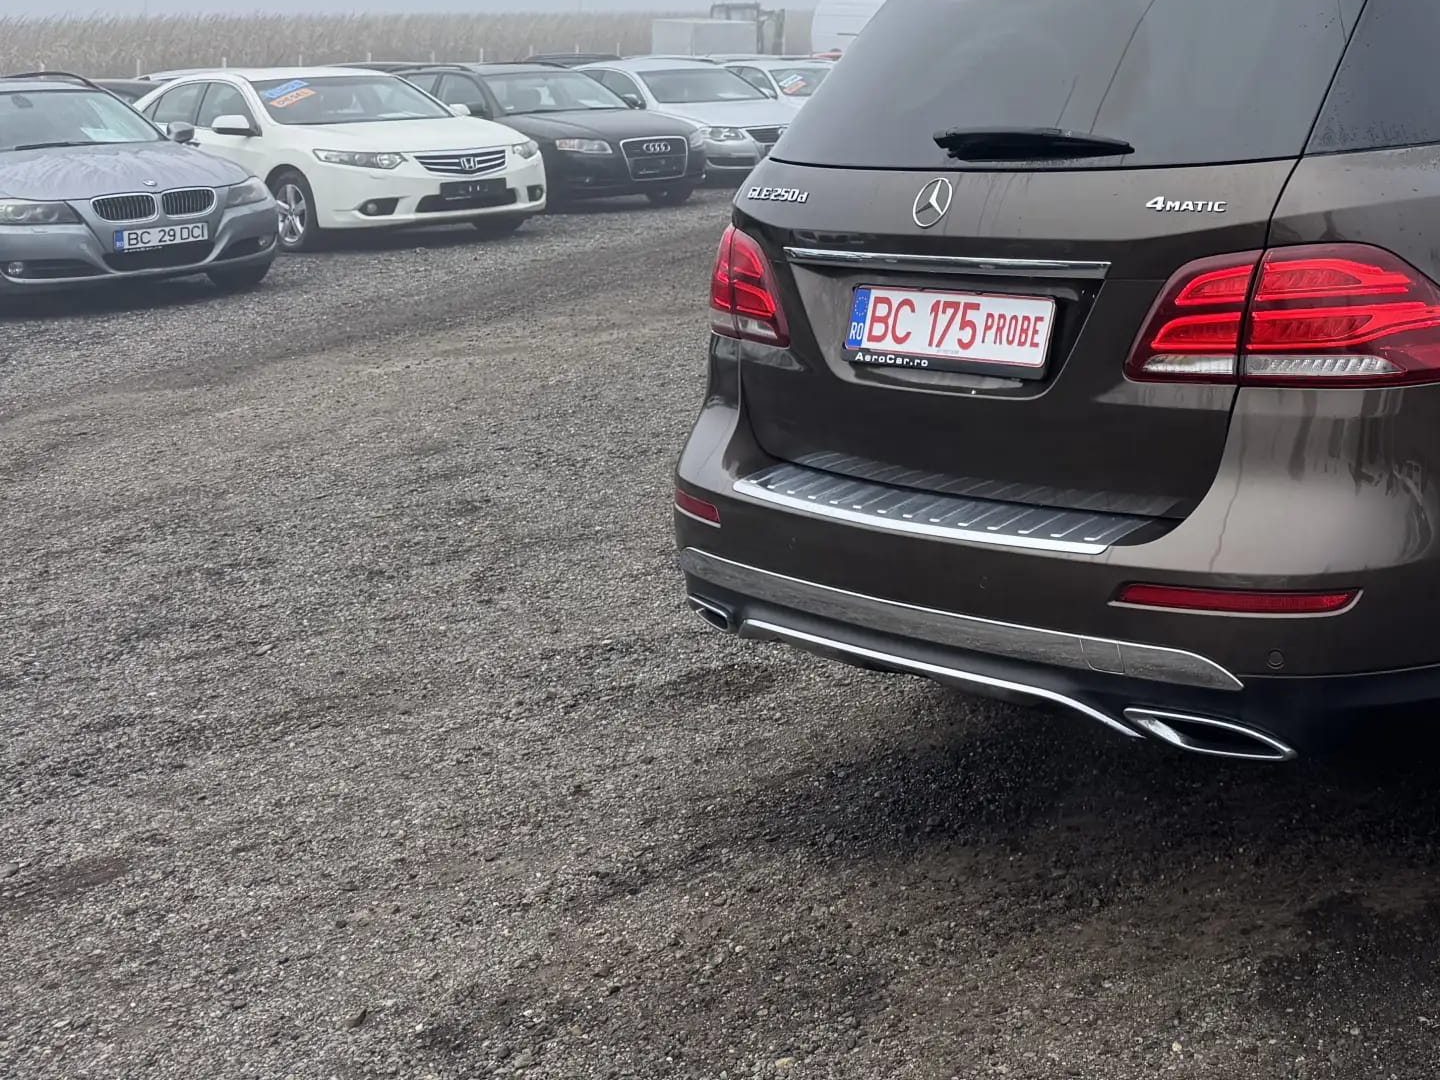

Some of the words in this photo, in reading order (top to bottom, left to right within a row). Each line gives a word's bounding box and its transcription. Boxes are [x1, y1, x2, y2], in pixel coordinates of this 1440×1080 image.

[1145, 196, 1227, 212] 4MATIC
[127, 231, 151, 246] BC
[158, 228, 176, 243] 29
[180, 224, 205, 240] DCI
[849, 321, 864, 341] RO
[866, 296, 916, 345] BC
[927, 299, 981, 350] 175
[981, 312, 1045, 348] PROBE
[854, 352, 929, 368] AeroCar.ro
